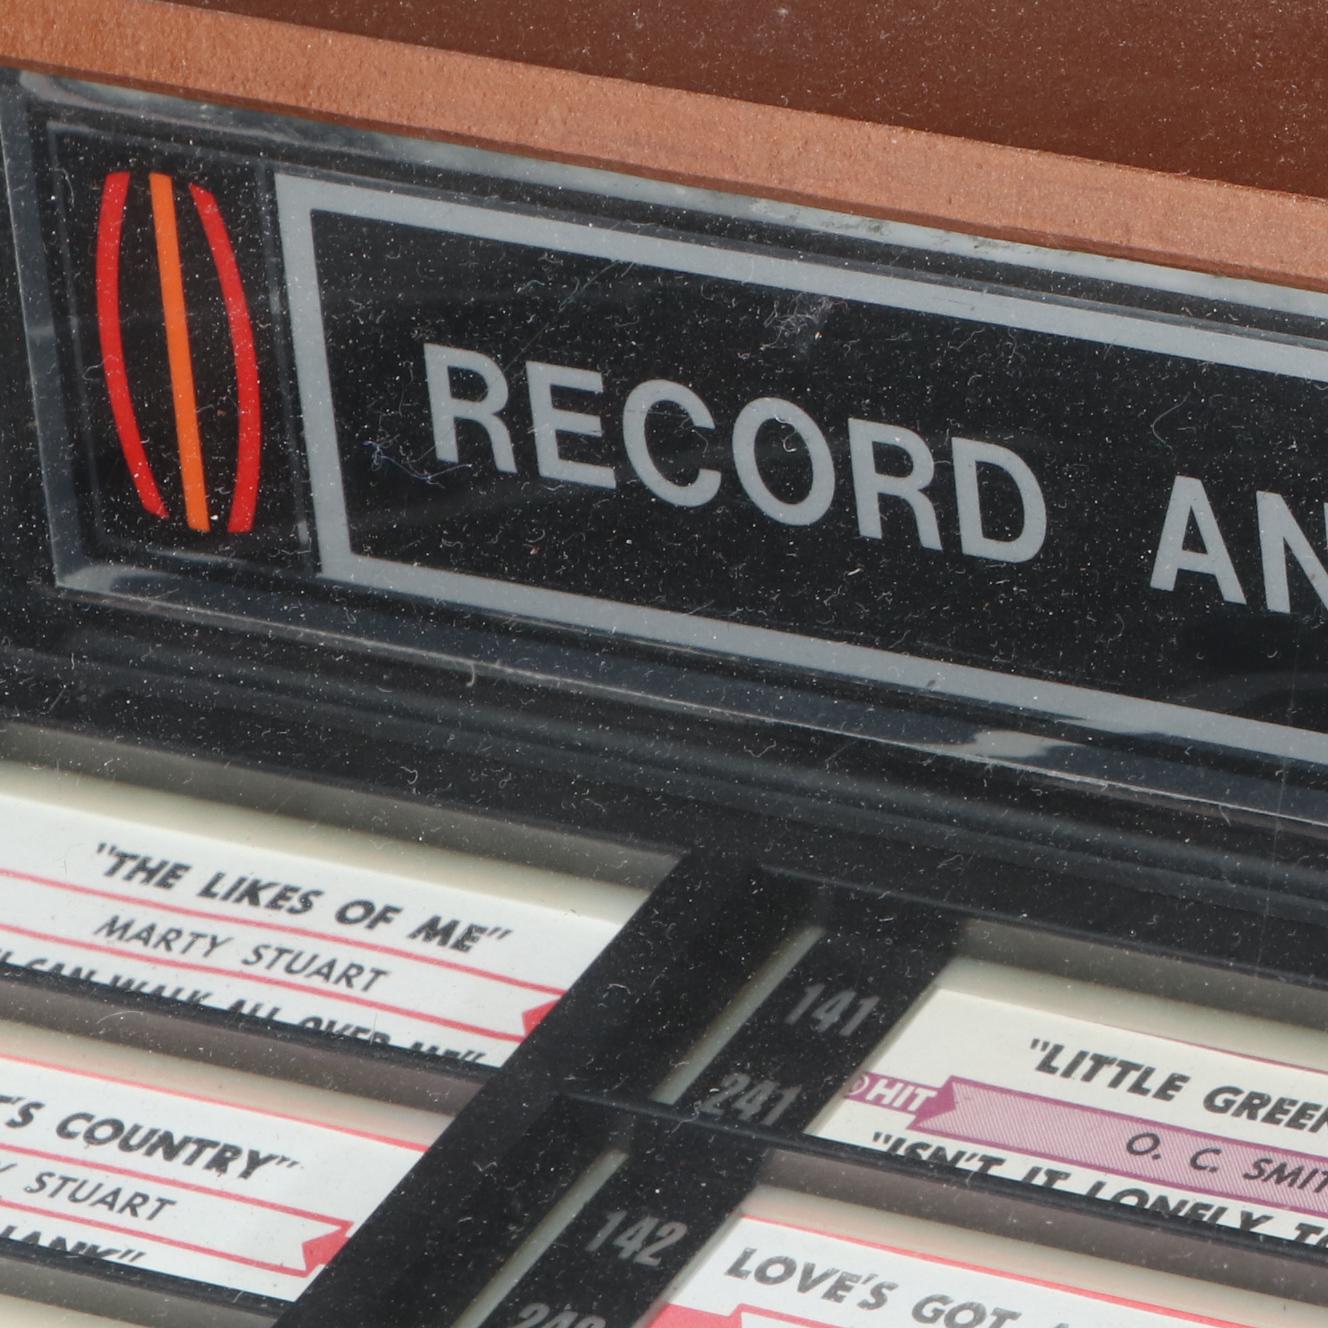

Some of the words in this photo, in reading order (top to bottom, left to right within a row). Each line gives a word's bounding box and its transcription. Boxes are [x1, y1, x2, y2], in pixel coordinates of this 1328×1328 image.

[422, 342, 1047, 565] RECORD
[96, 841, 191, 891] "THE
[196, 870, 322, 917] LIKES
[335, 896, 404, 935] OF
[408, 915, 513, 955] ME"
[93, 913, 233, 960] MARTY
[242, 942, 391, 994] STUART
[784, 983, 881, 1037] 141
[866, 1078, 938, 1111] HIT
[1030, 1037, 1190, 1101] "LITTLE
[701, 1074, 802, 1126] 241
[1127, 1132, 1162, 1160] O.
[1189, 1148, 1221, 1174] C.
[24, 1172, 177, 1221] STUART
[585, 1210, 687, 1266] 142
[723, 1247, 899, 1310] LOVE'S
